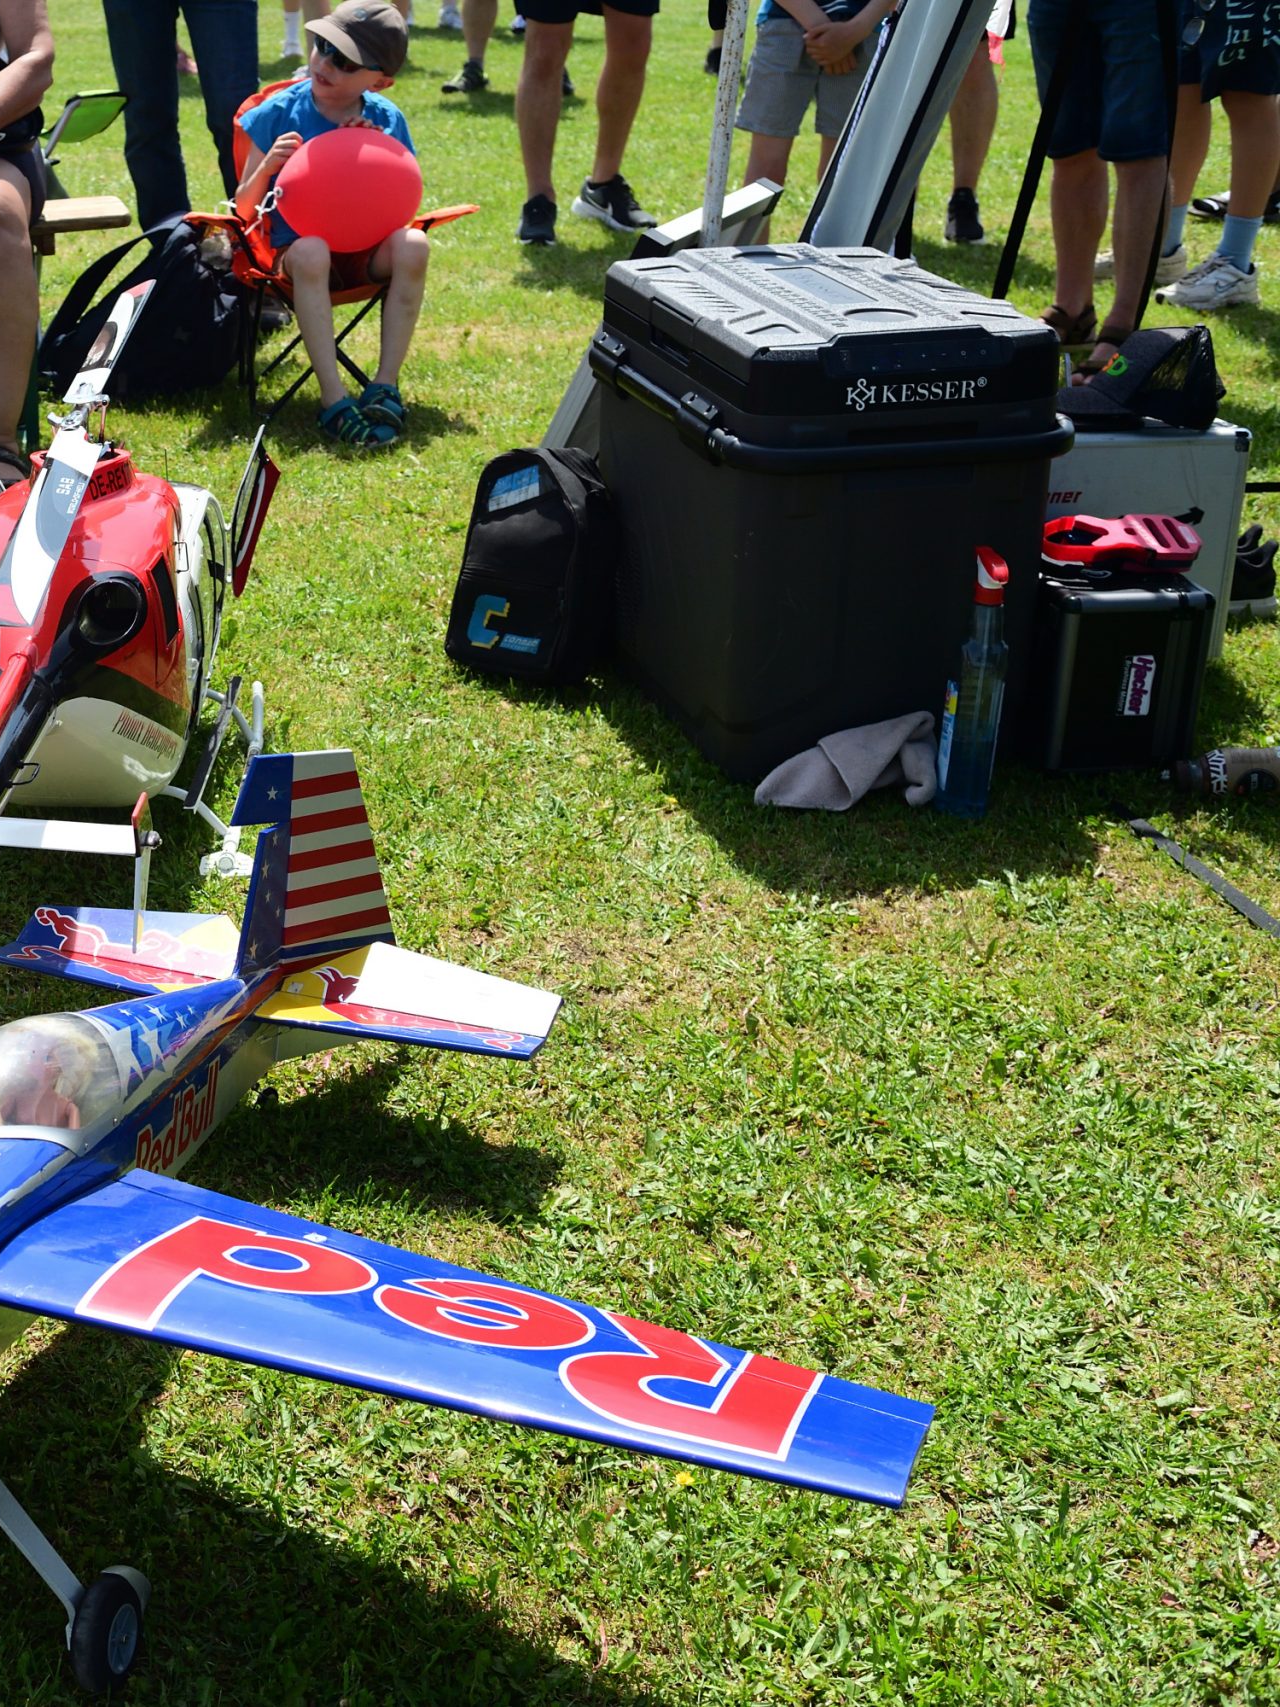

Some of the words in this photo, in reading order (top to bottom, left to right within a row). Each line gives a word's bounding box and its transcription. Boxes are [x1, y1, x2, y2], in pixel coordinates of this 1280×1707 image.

[56, 477, 75, 495] SAB
[1128, 656, 1154, 715] Hacker
[135, 1095, 180, 1174] Red
[177, 1059, 220, 1157] Bull
[73, 1215, 825, 1461] Red
